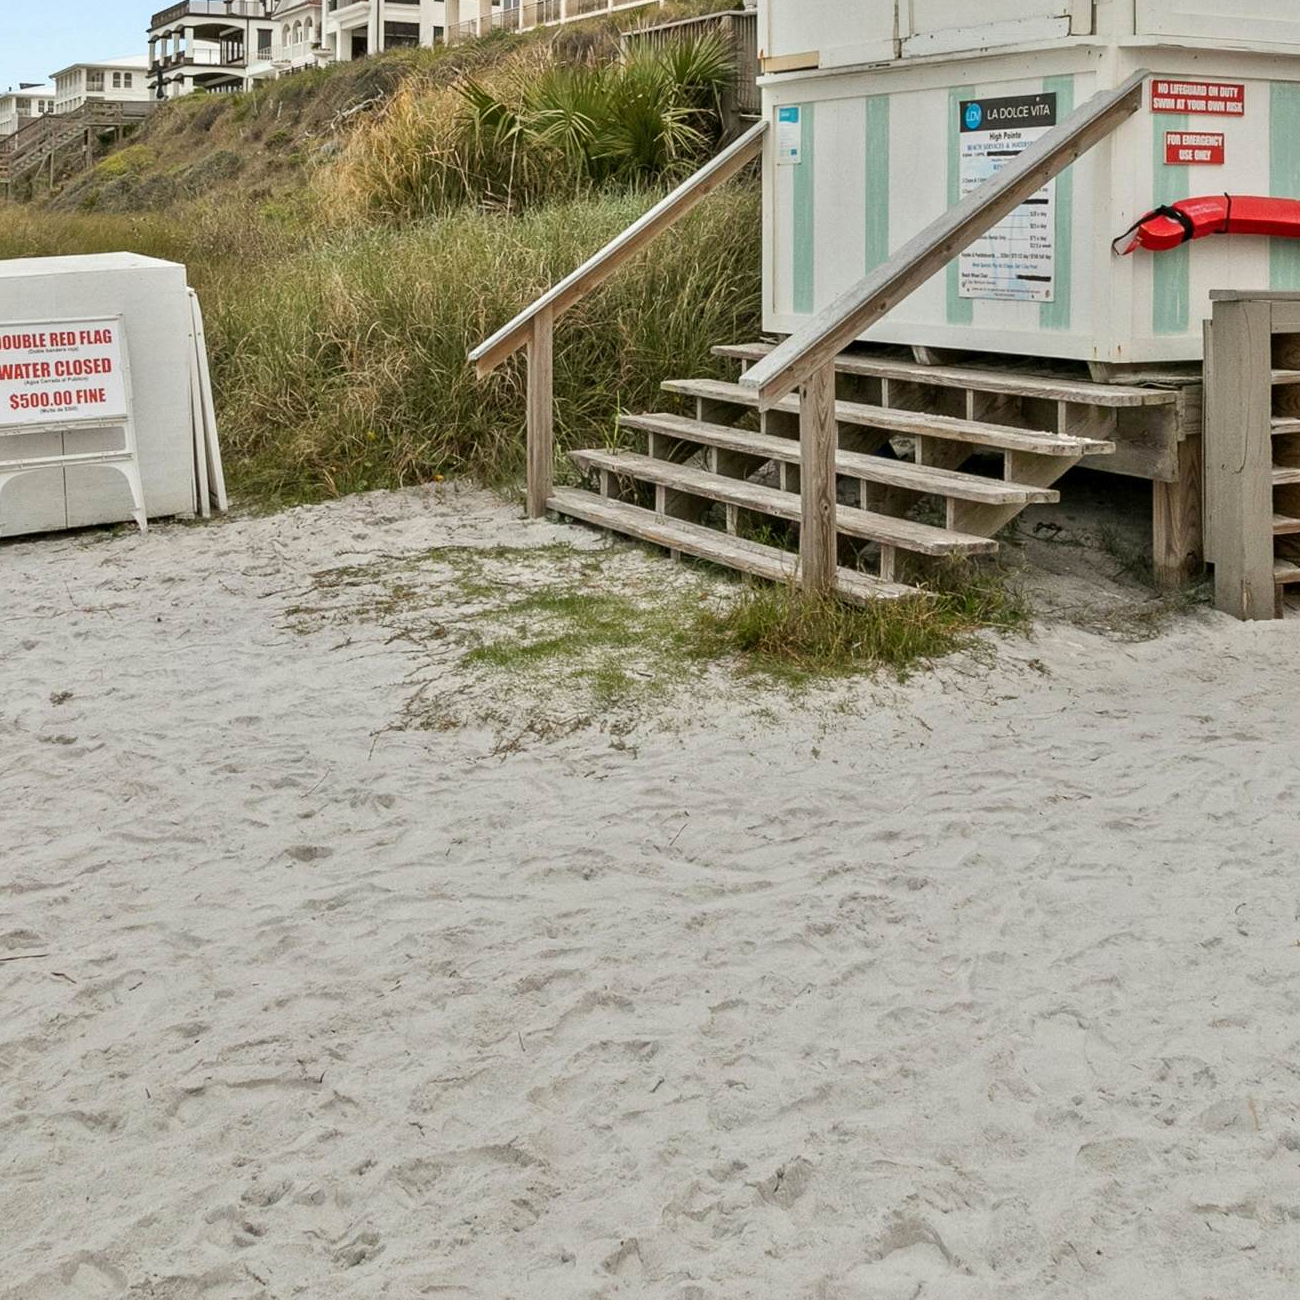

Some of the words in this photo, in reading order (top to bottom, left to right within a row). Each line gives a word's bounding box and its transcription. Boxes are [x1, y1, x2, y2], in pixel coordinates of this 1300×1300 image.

[1158, 83, 1168, 94] NO
[1170, 83, 1207, 96] LIFEGUARD
[1208, 86, 1219, 97] ON
[1220, 86, 1238, 98] DUTY
[987, 108, 998, 120] LA
[1000, 106, 1029, 119] DOLCE
[1031, 104, 1050, 116] VITA
[1153, 98, 1175, 109] SWIM
[1176, 99, 1186, 110] AT
[1187, 99, 1206, 111] YOUR
[1207, 101, 1225, 112] OWN
[1226, 101, 1243, 112] RISK
[990, 132, 1002, 141] High
[1004, 132, 1022, 140] Pointe
[1167, 134, 1181, 145] FOR
[1182, 135, 1223, 146] EMERGENCY
[1179, 150, 1193, 160] USE
[1194, 150, 1211, 160] ONLY
[49, 331, 76, 347] RED
[80, 329, 112, 345] FLAG
[54, 358, 112, 377] CLOSED
[9, 390, 73, 410] $500.00
[76, 388, 106, 404] FINE
